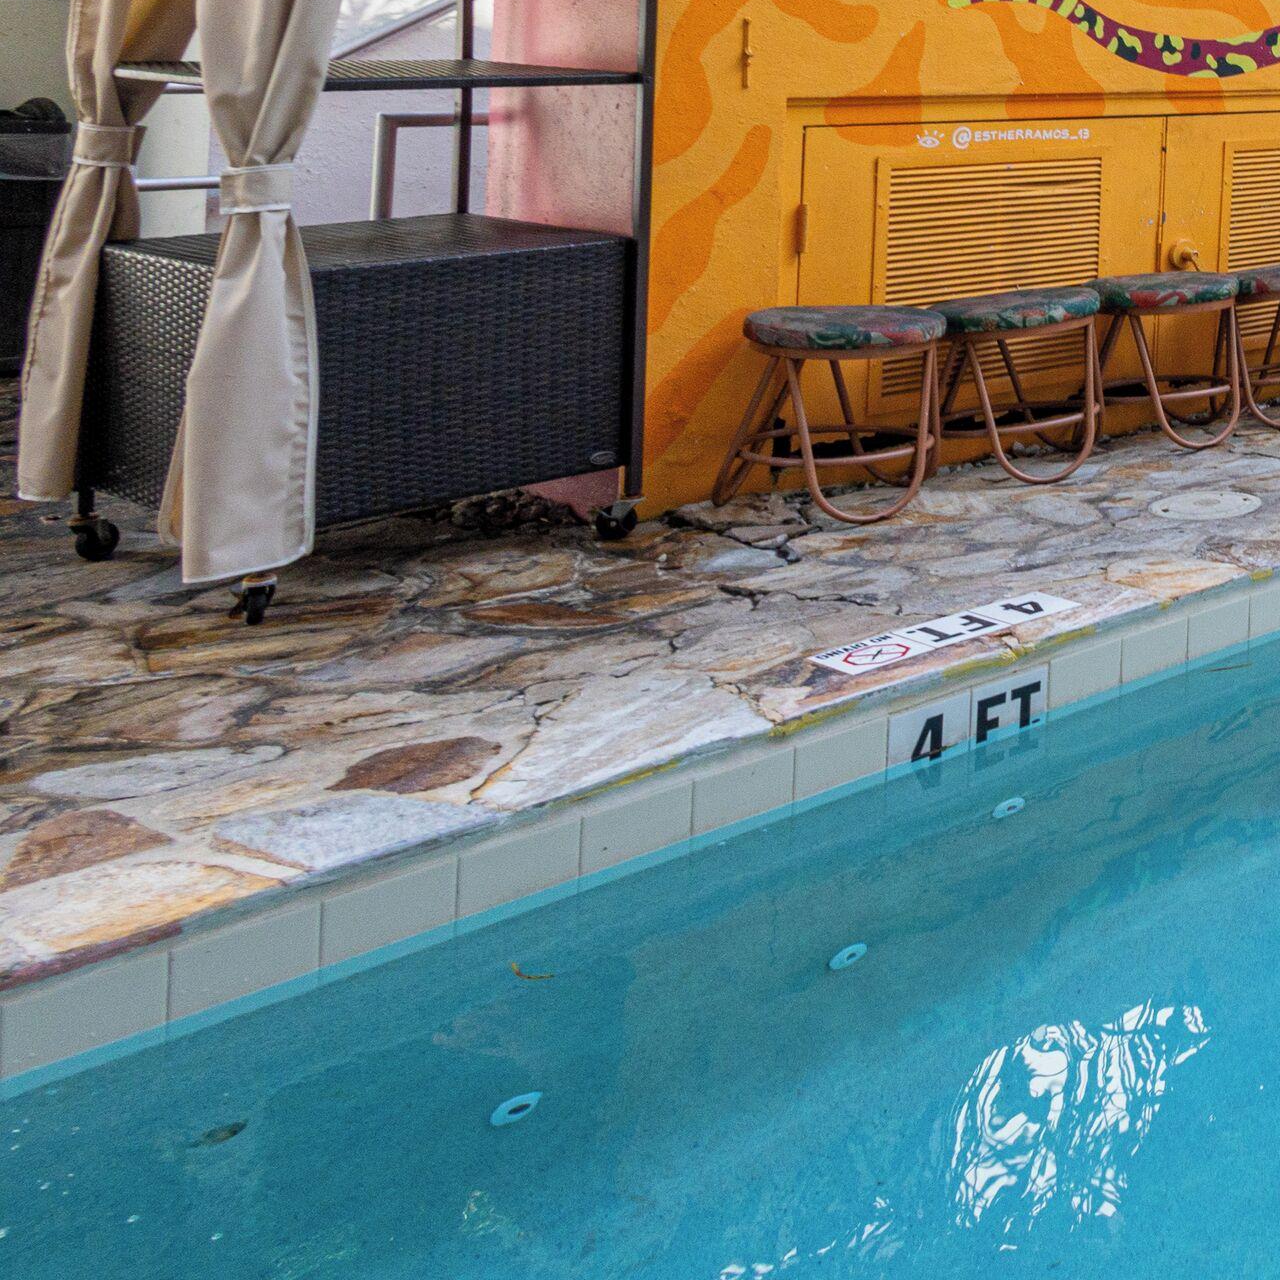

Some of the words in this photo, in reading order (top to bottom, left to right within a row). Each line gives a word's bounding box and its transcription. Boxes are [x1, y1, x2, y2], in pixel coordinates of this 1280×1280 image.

[1000, 600, 1044, 615] 4
[869, 634, 893, 643] NO
[815, 642, 869, 660] DIVING
[910, 713, 944, 763] 4
